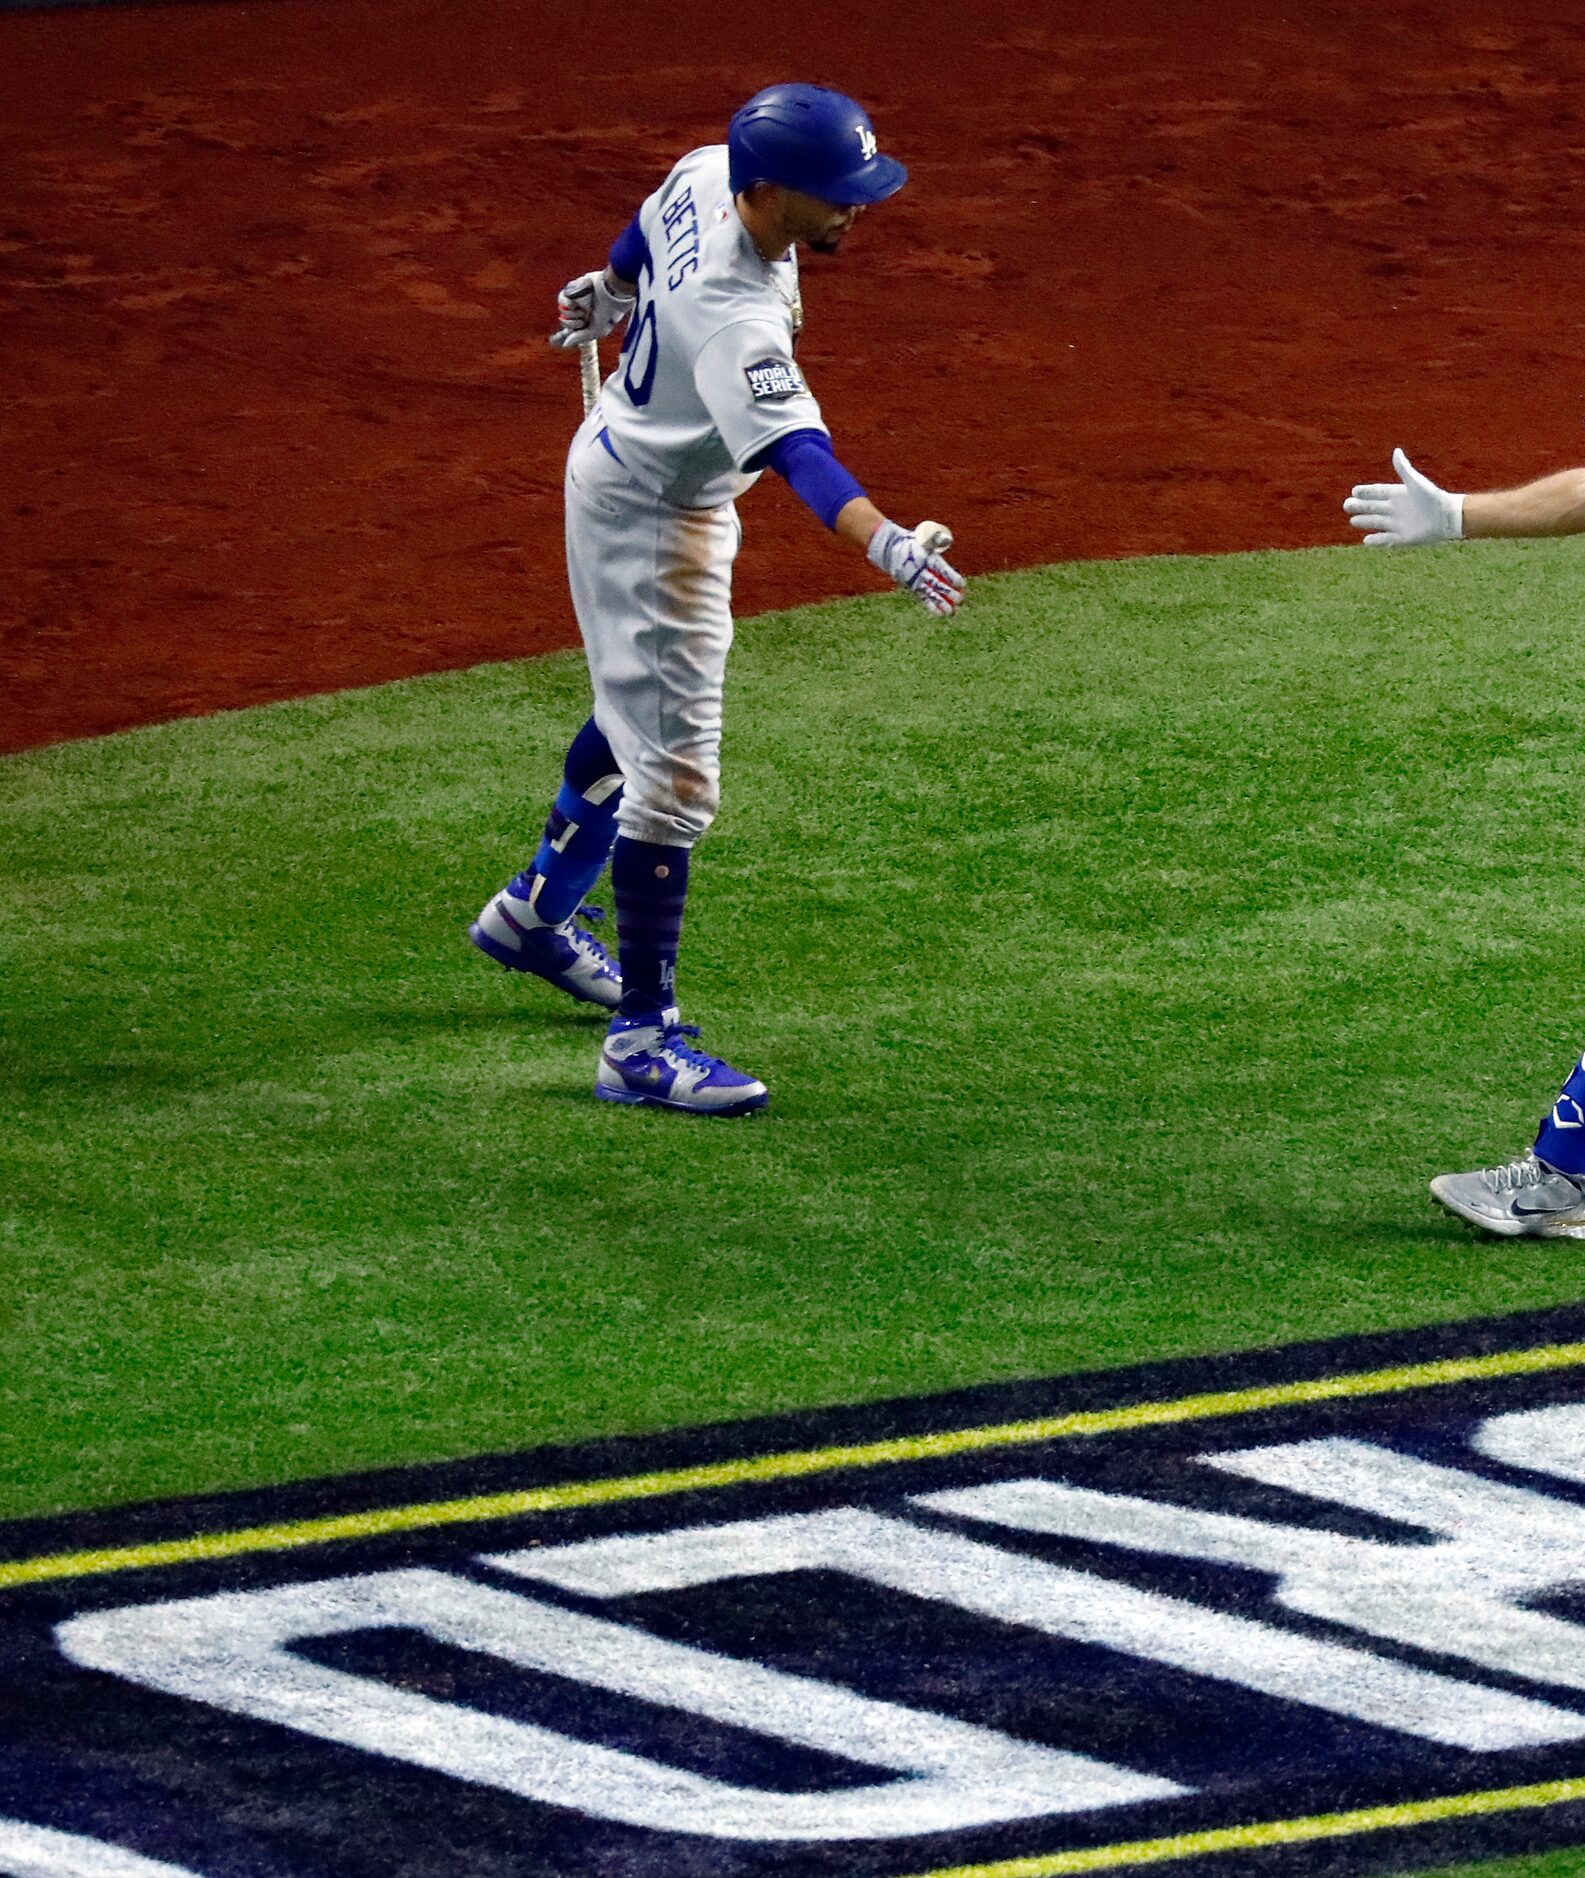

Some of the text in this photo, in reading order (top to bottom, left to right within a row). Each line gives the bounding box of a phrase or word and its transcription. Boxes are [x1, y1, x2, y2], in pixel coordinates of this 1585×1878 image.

[855, 125, 878, 161] LA
[661, 185, 700, 291] BETTS
[747, 366, 800, 383] WORLD
[751, 378, 805, 397] SERIES
